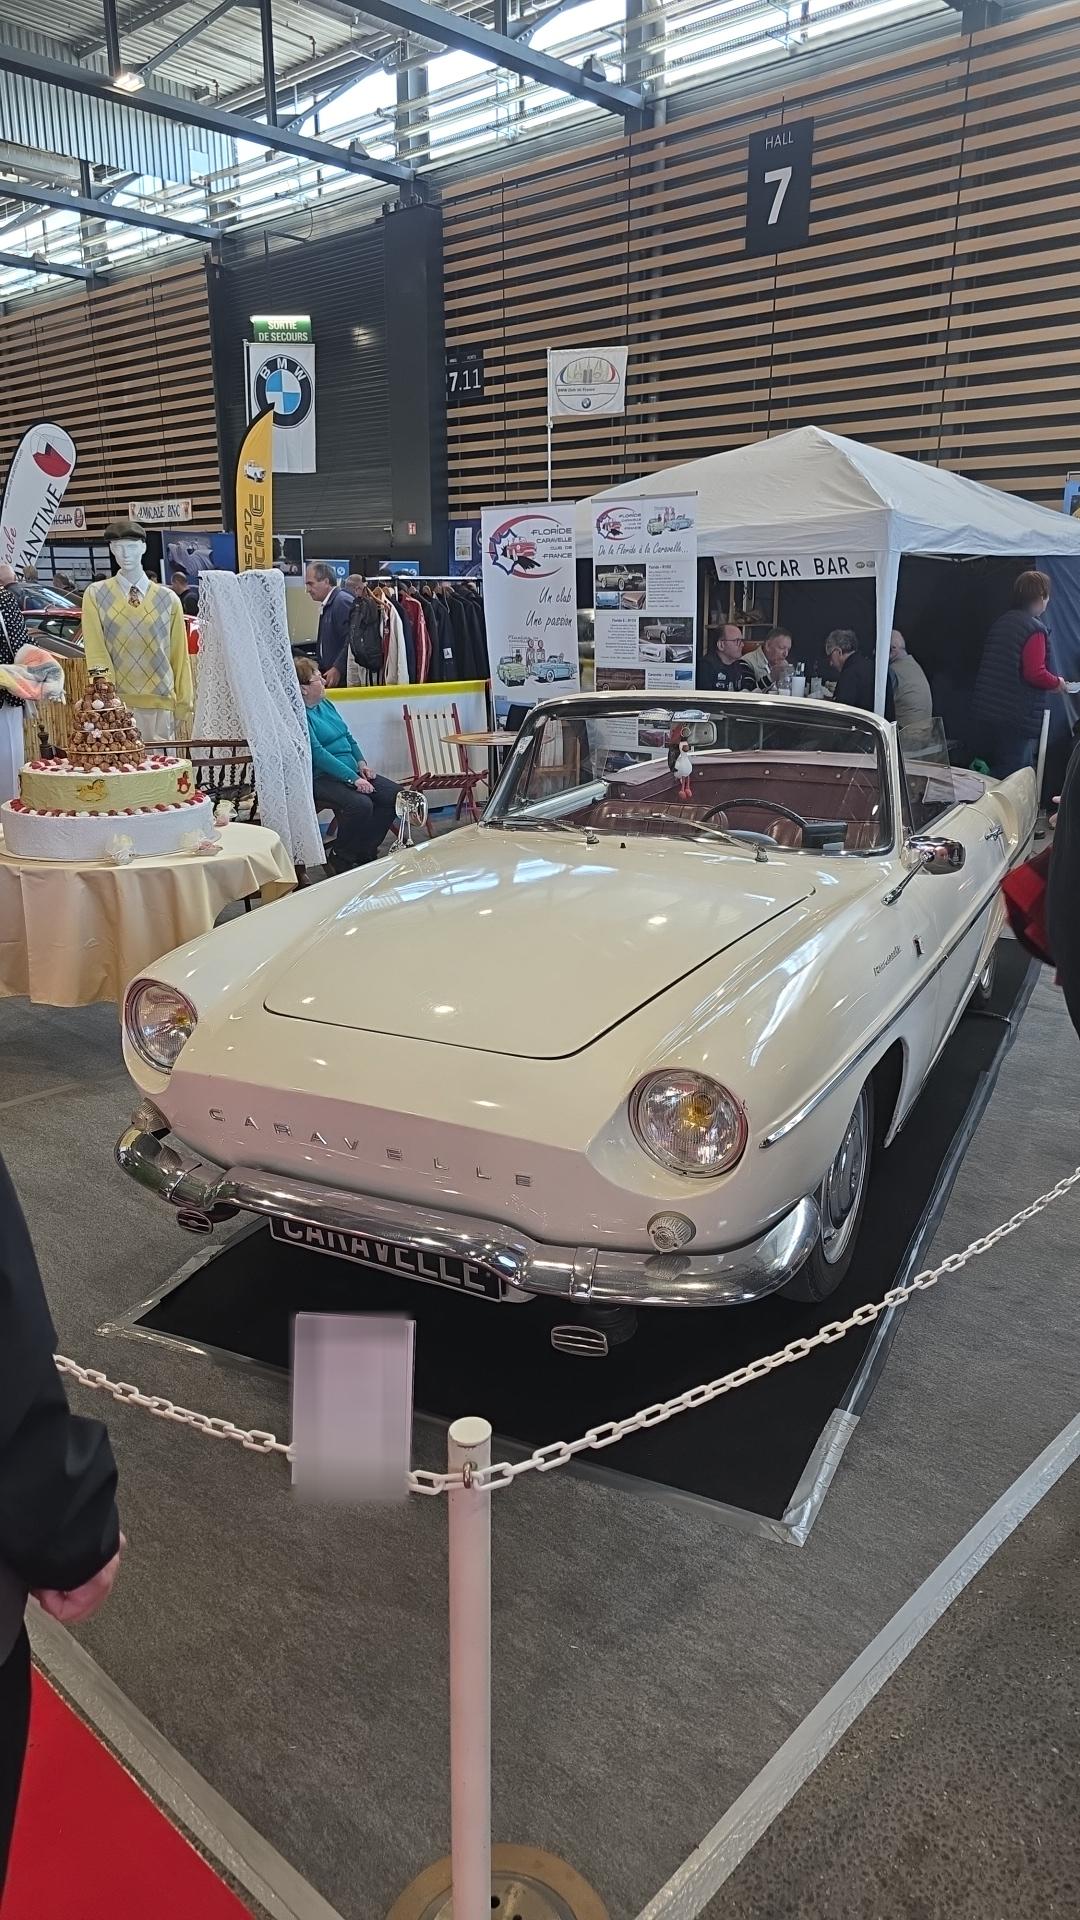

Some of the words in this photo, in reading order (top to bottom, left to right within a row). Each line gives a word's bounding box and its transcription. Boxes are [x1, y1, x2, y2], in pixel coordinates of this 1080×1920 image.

[765, 131, 794, 150] HALL
[764, 166, 793, 225] 7
[267, 320, 297, 330] SORTIE
[258, 332, 270, 341] DE
[270, 332, 308, 342] SECOURS
[260, 357, 307, 380] BMW
[449, 368, 481, 392] 7.11
[136, 505, 165, 519] AMICALE
[248, 493, 265, 570] ICALE
[531, 524, 572, 536] FLORIDE
[615, 543, 636, 555] Floride
[735, 559, 801, 578] FLOCAR
[813, 556, 851, 576] BAR
[539, 586, 552, 604] Un
[556, 586, 571, 603] club
[526, 610, 542, 627] Une
[544, 613, 572, 632] passion
[209, 1107, 533, 1188] CARAVELLE
